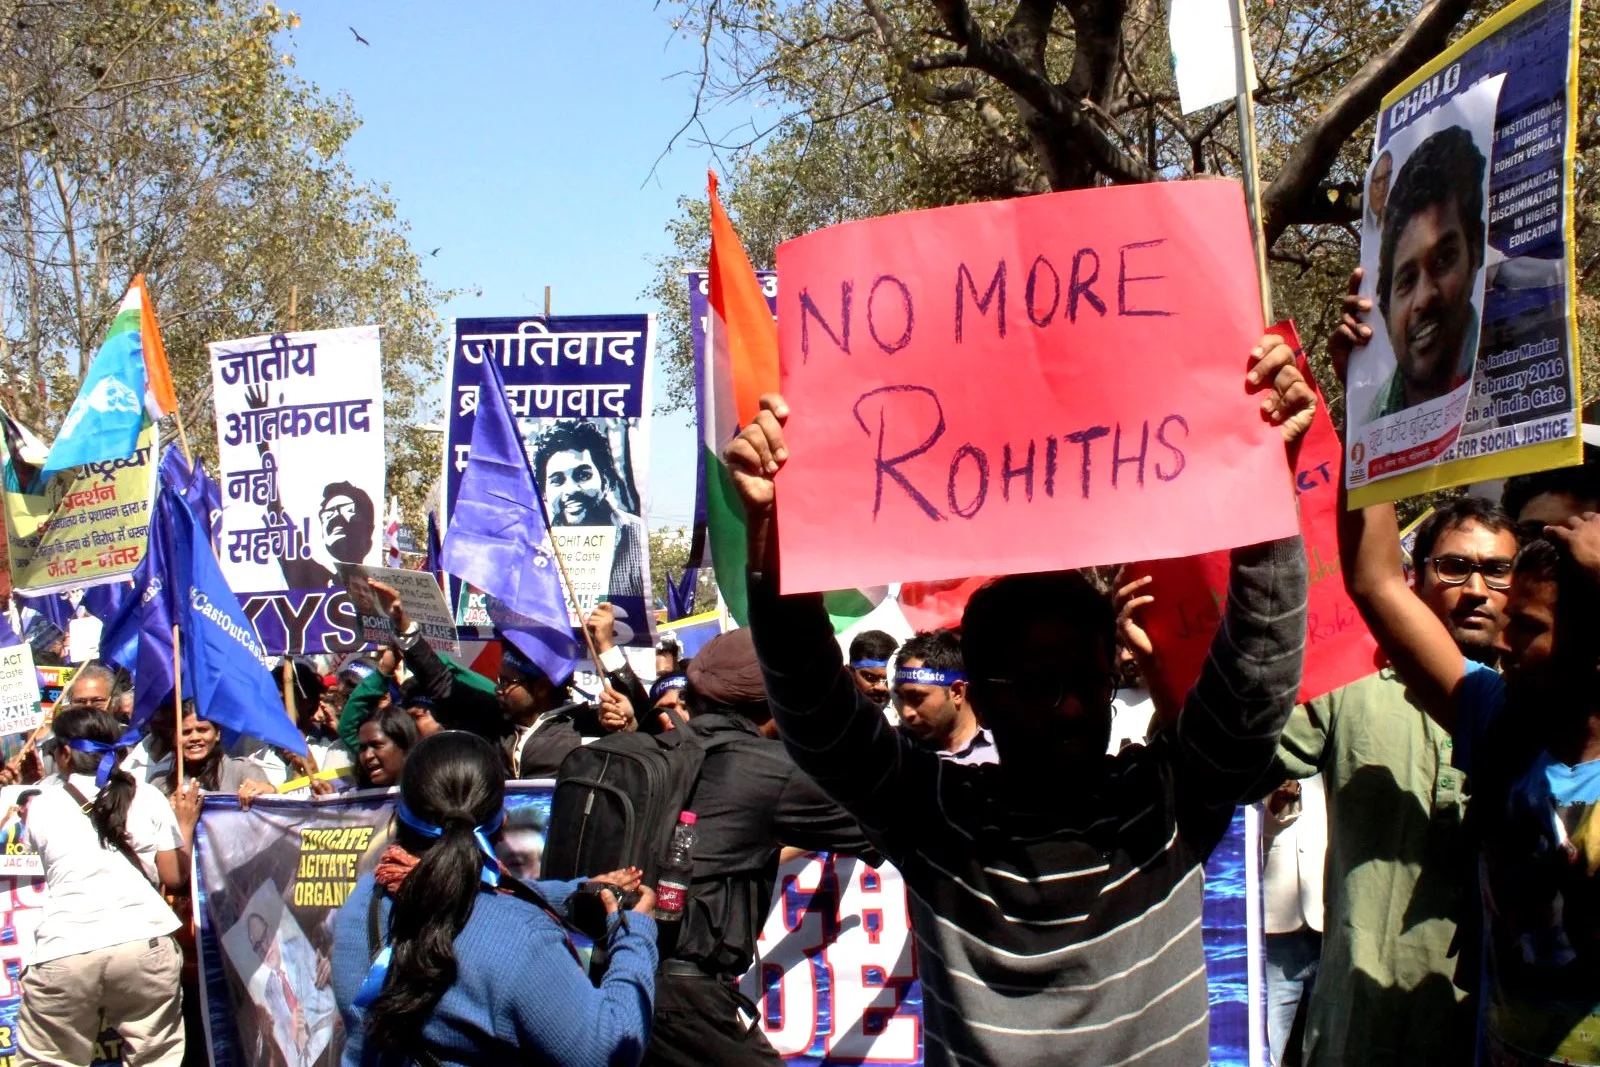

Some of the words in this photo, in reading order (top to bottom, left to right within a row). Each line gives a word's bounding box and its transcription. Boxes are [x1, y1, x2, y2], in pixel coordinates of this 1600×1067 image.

[1501, 100, 1562, 138] INSTITUTIONAL
[1514, 124, 1549, 148] MURDER
[1551, 116, 1562, 131] OF
[1494, 152, 1524, 174] ROHITH
[1526, 133, 1561, 159] VEMULA
[1491, 184, 1558, 222] DISCRIMINATION
[1499, 168, 1559, 204] BRAHMANICAL
[1508, 219, 1557, 249] EDUCATION
[1514, 217, 1523, 230] IN
[1525, 202, 1558, 226] HIGHER
[799, 275, 914, 363] NO
[955, 239, 1179, 343] MORE
[218, 334, 317, 385] जातीय
[461, 322, 641, 367] जातिवाद
[1487, 350, 1519, 370] Jantar
[1520, 339, 1559, 360] Mantar
[1475, 370, 1529, 397] February
[1529, 357, 1564, 383] 2016
[224, 392, 372, 446] आतंकवाद
[1483, 404, 1494, 418] at
[1497, 394, 1531, 417] India
[1532, 385, 1566, 409] Gate
[853, 384, 1189, 521] ROHITHS
[1457, 439, 1478, 458] FOR
[1480, 428, 1520, 453] SOCIAL
[1522, 418, 1568, 444] JUSTICE
[1295, 461, 1331, 496] CT
[300, 827, 374, 851] EDUCATE
[297, 854, 358, 878] AGITATE
